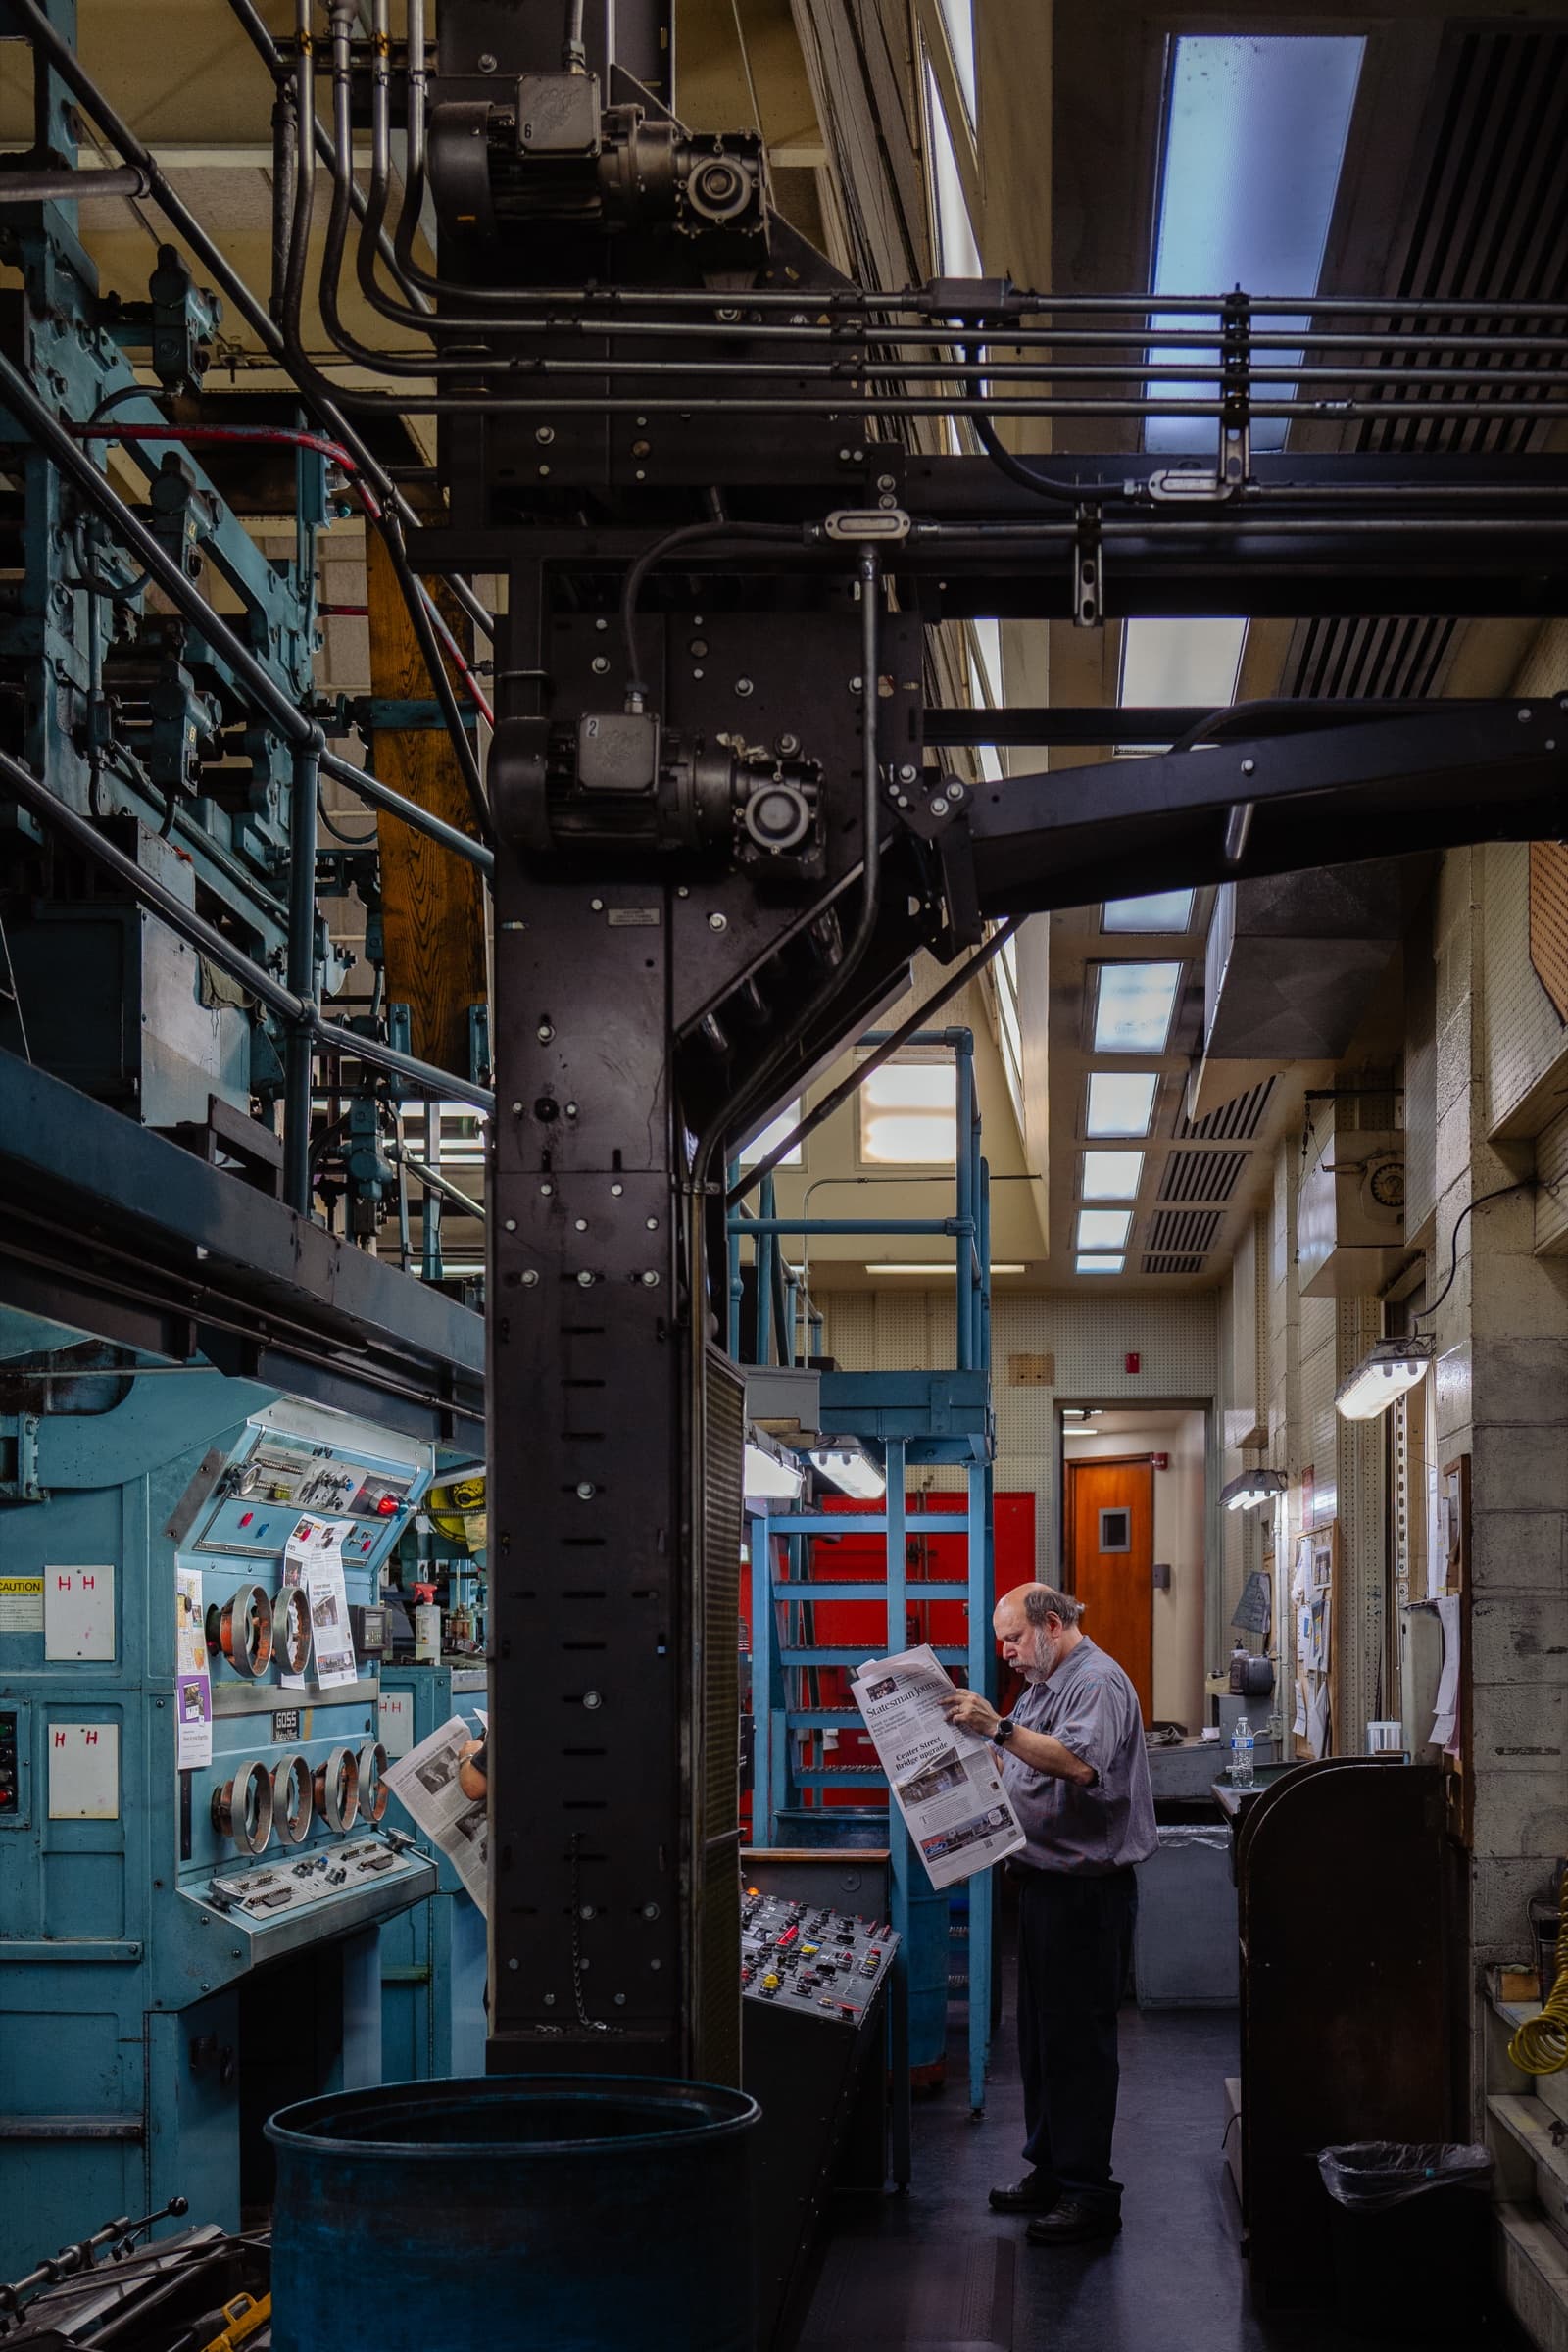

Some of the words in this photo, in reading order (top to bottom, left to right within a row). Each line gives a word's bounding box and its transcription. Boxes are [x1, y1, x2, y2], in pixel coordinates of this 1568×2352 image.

[524, 123, 532, 139] 6
[589, 720, 597, 737] 2
[58, 1575, 71, 1591] H
[82, 1574, 95, 1590] H
[866, 1690, 916, 1718] Statesman
[276, 1710, 297, 1729] GOSS
[55, 1731, 65, 1748] H
[86, 1730, 98, 1745] H
[895, 1756, 919, 1772] Bridge
[919, 1741, 948, 1761] upgrade
[896, 1747, 919, 1762] Center
[919, 1736, 942, 1751] Street
